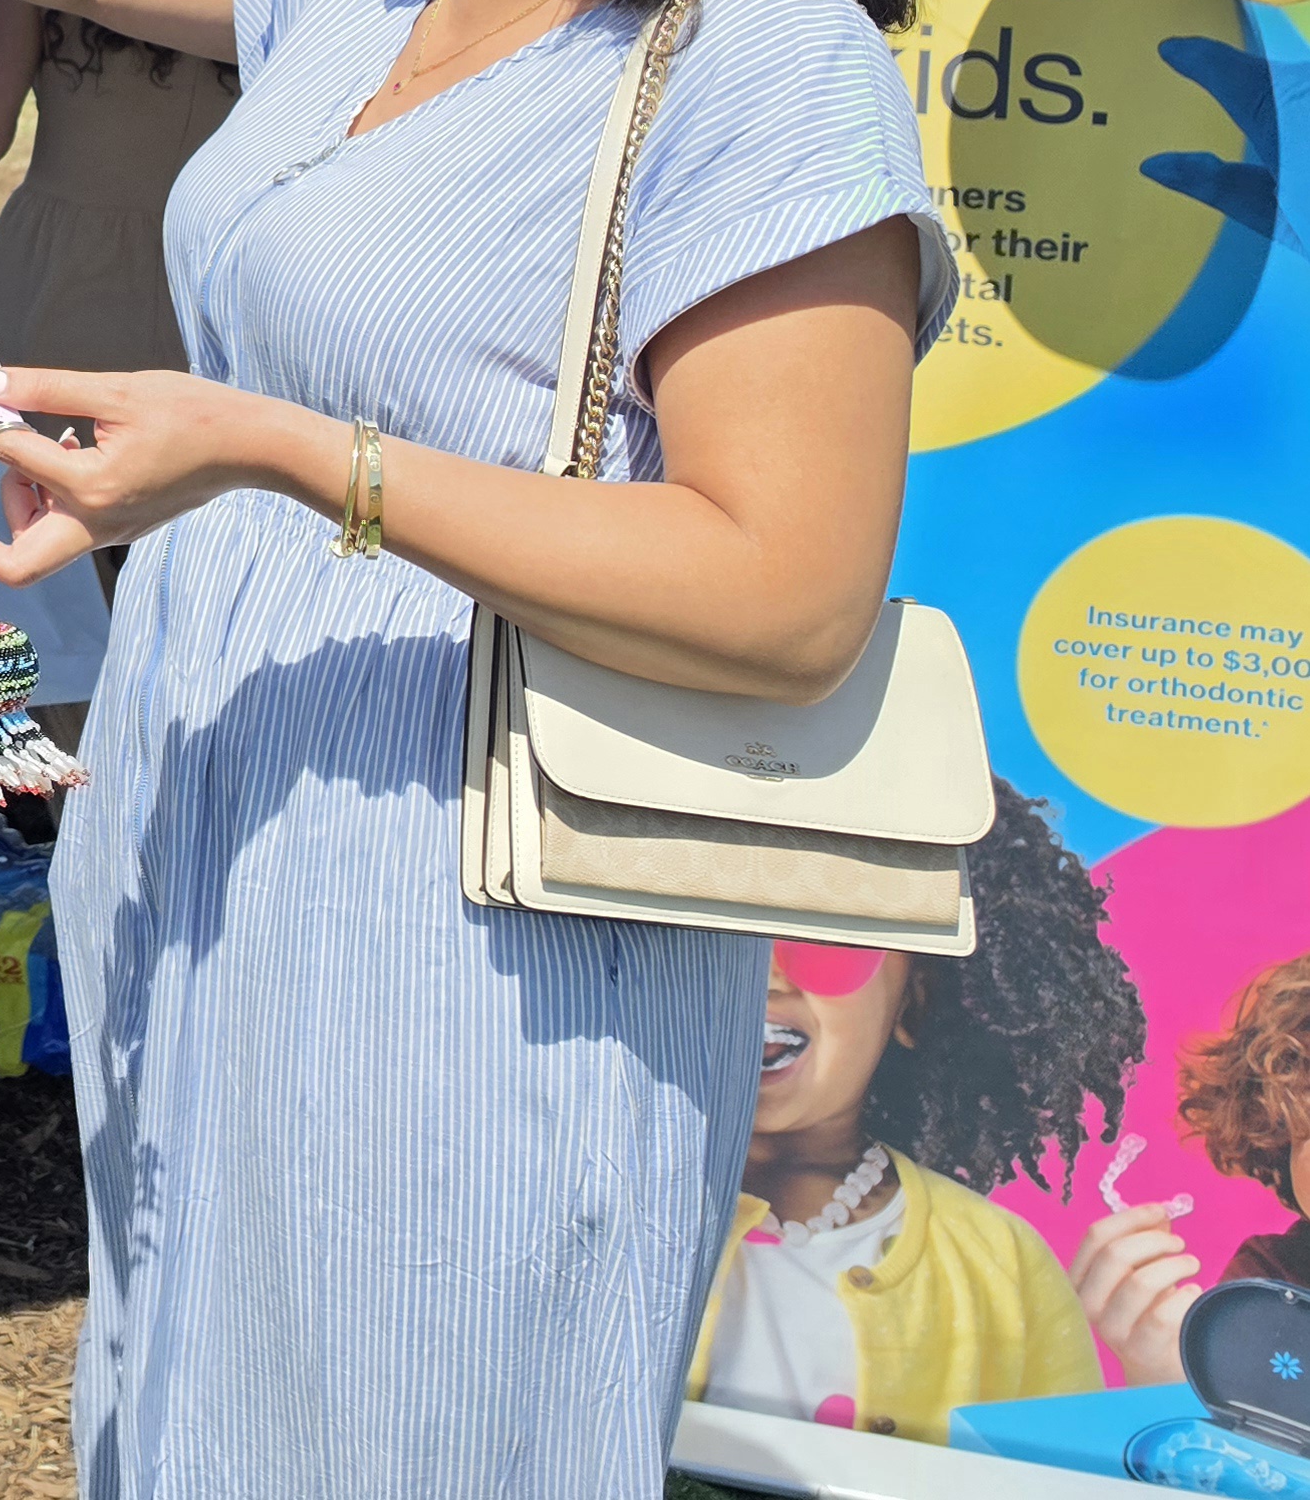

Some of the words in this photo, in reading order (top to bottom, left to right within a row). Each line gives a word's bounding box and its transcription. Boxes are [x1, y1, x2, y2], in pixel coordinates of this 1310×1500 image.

[894, 24, 1108, 125] ids.
[930, 186, 1027, 213] ners
[946, 230, 980, 253] or
[992, 228, 1089, 263] their
[961, 272, 1013, 303] tal
[1086, 605, 1232, 638] Insurance
[1239, 622, 1304, 649] may
[1053, 637, 1134, 660] cover
[1140, 647, 1177, 669] up
[1185, 646, 1215, 669] to
[1078, 667, 1120, 691] for
[1127, 676, 1304, 712] orthodontic
